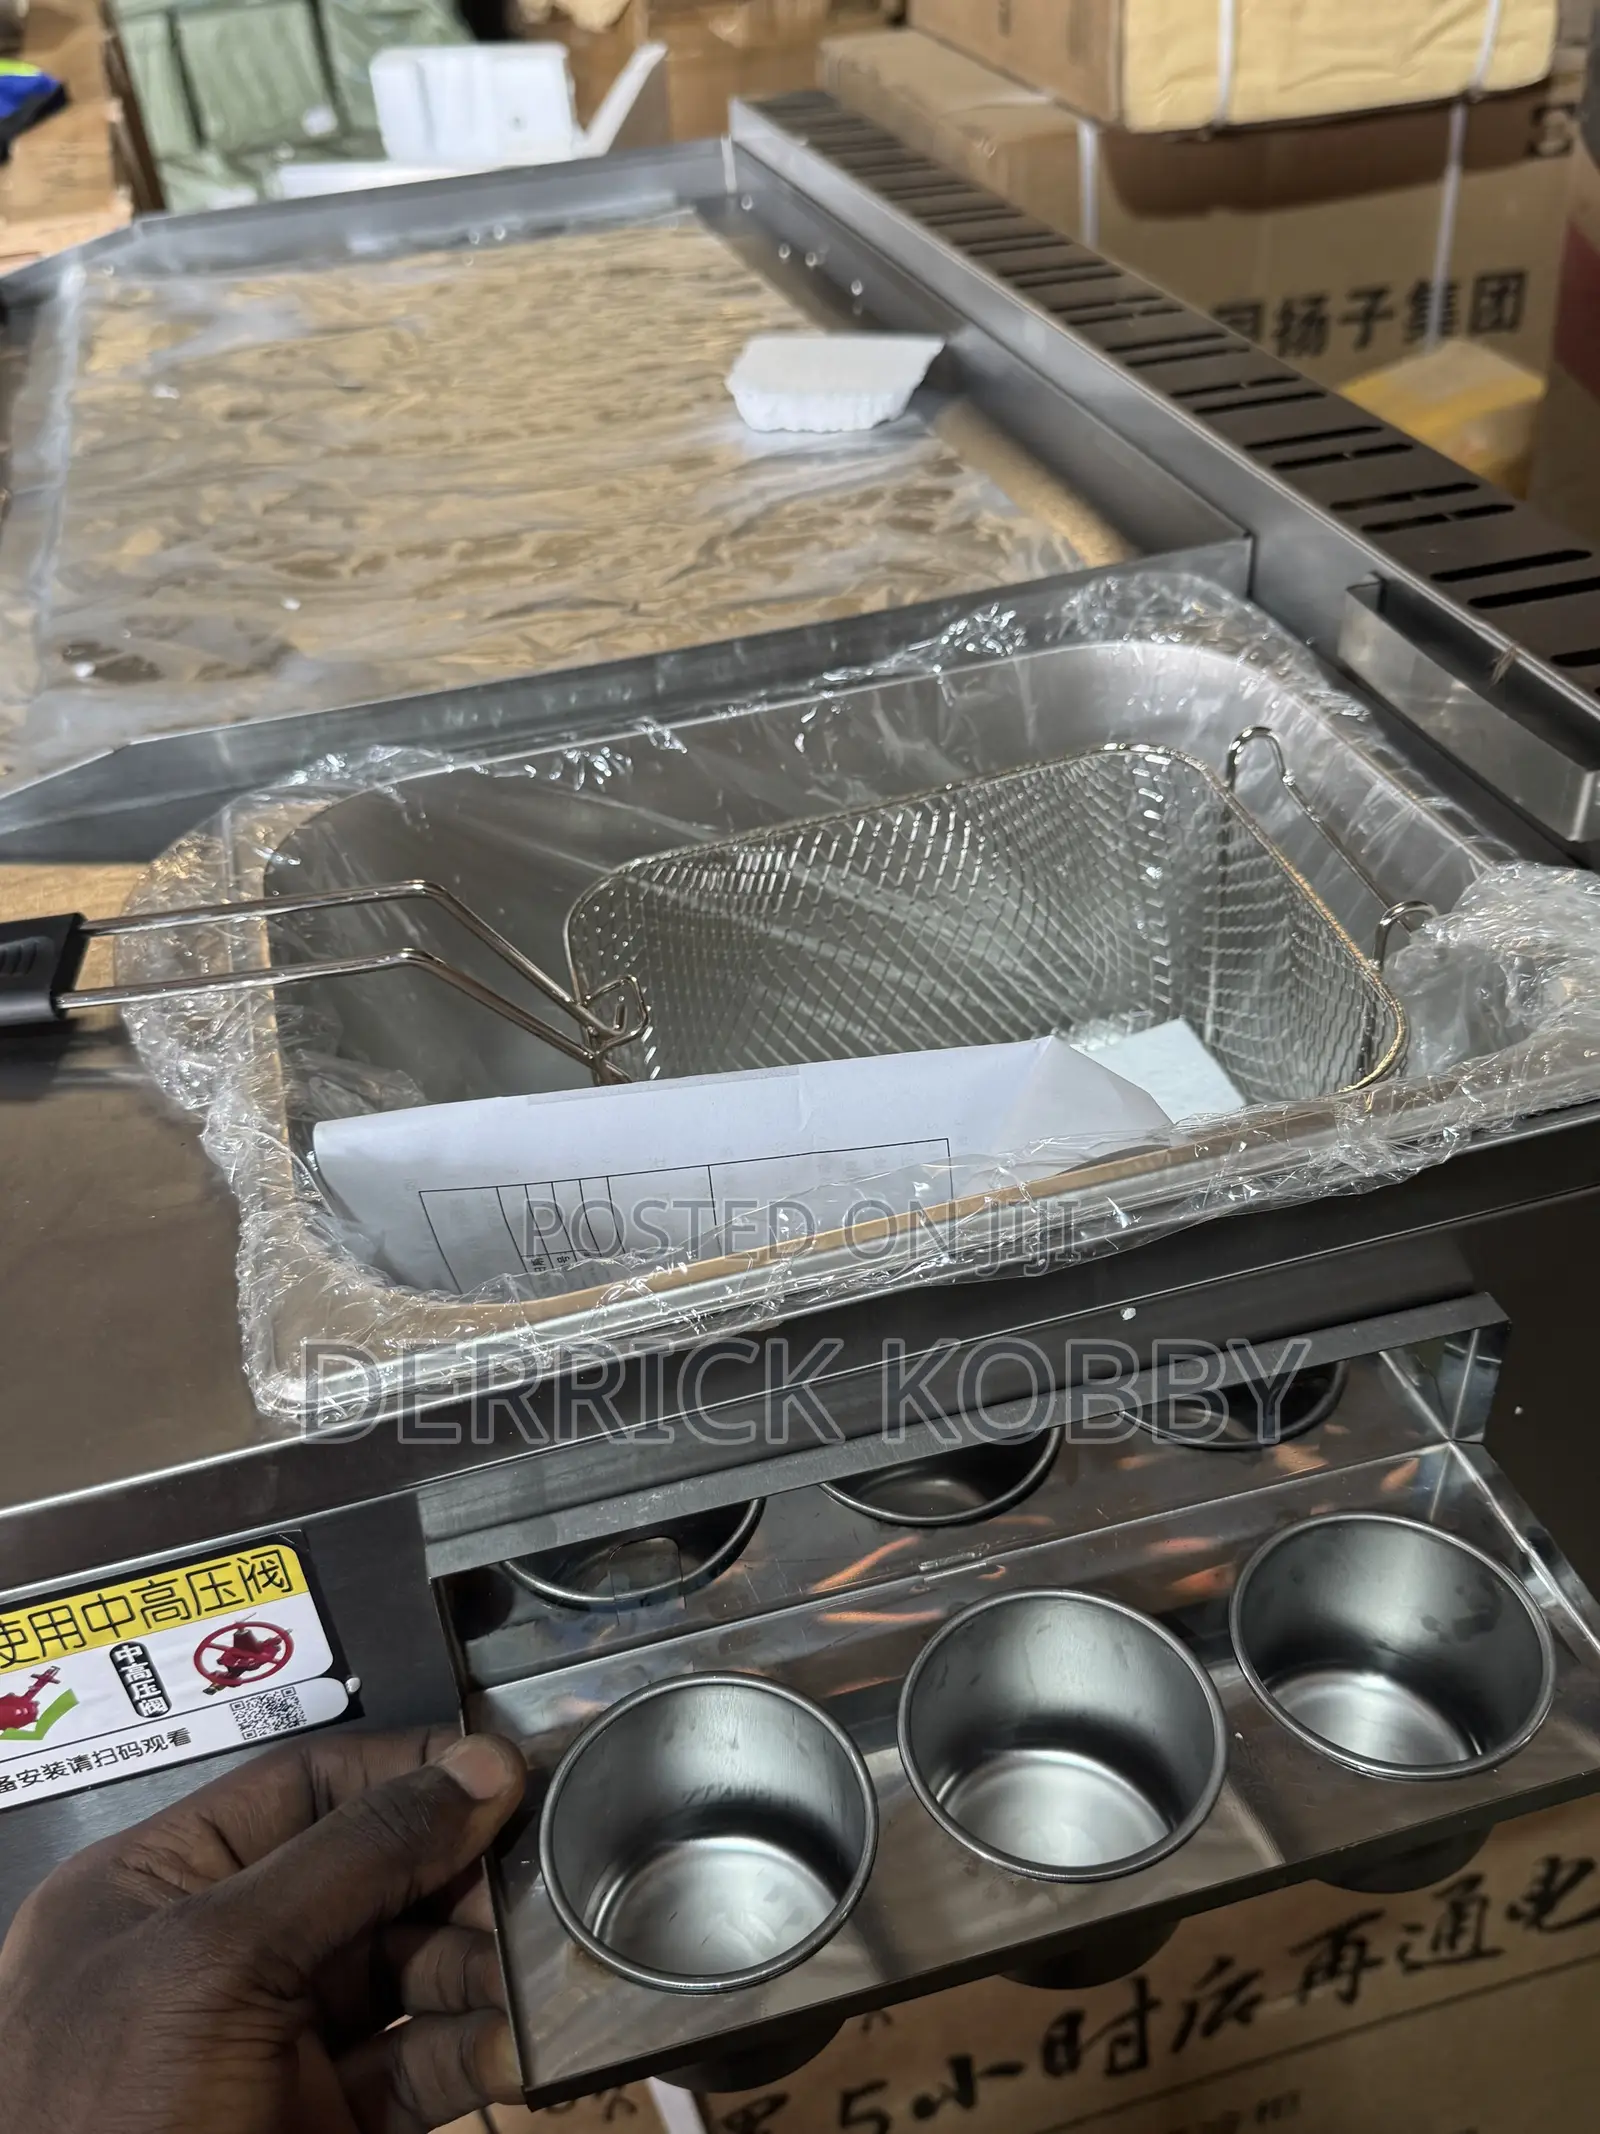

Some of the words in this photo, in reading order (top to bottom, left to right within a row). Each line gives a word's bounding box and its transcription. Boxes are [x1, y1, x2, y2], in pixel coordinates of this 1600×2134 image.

[0, 1549, 294, 1669] 使用中高压阀
[114, 1645, 169, 1716] 中高压阀
[0, 1727, 192, 1793] 备安装请扫码观看
